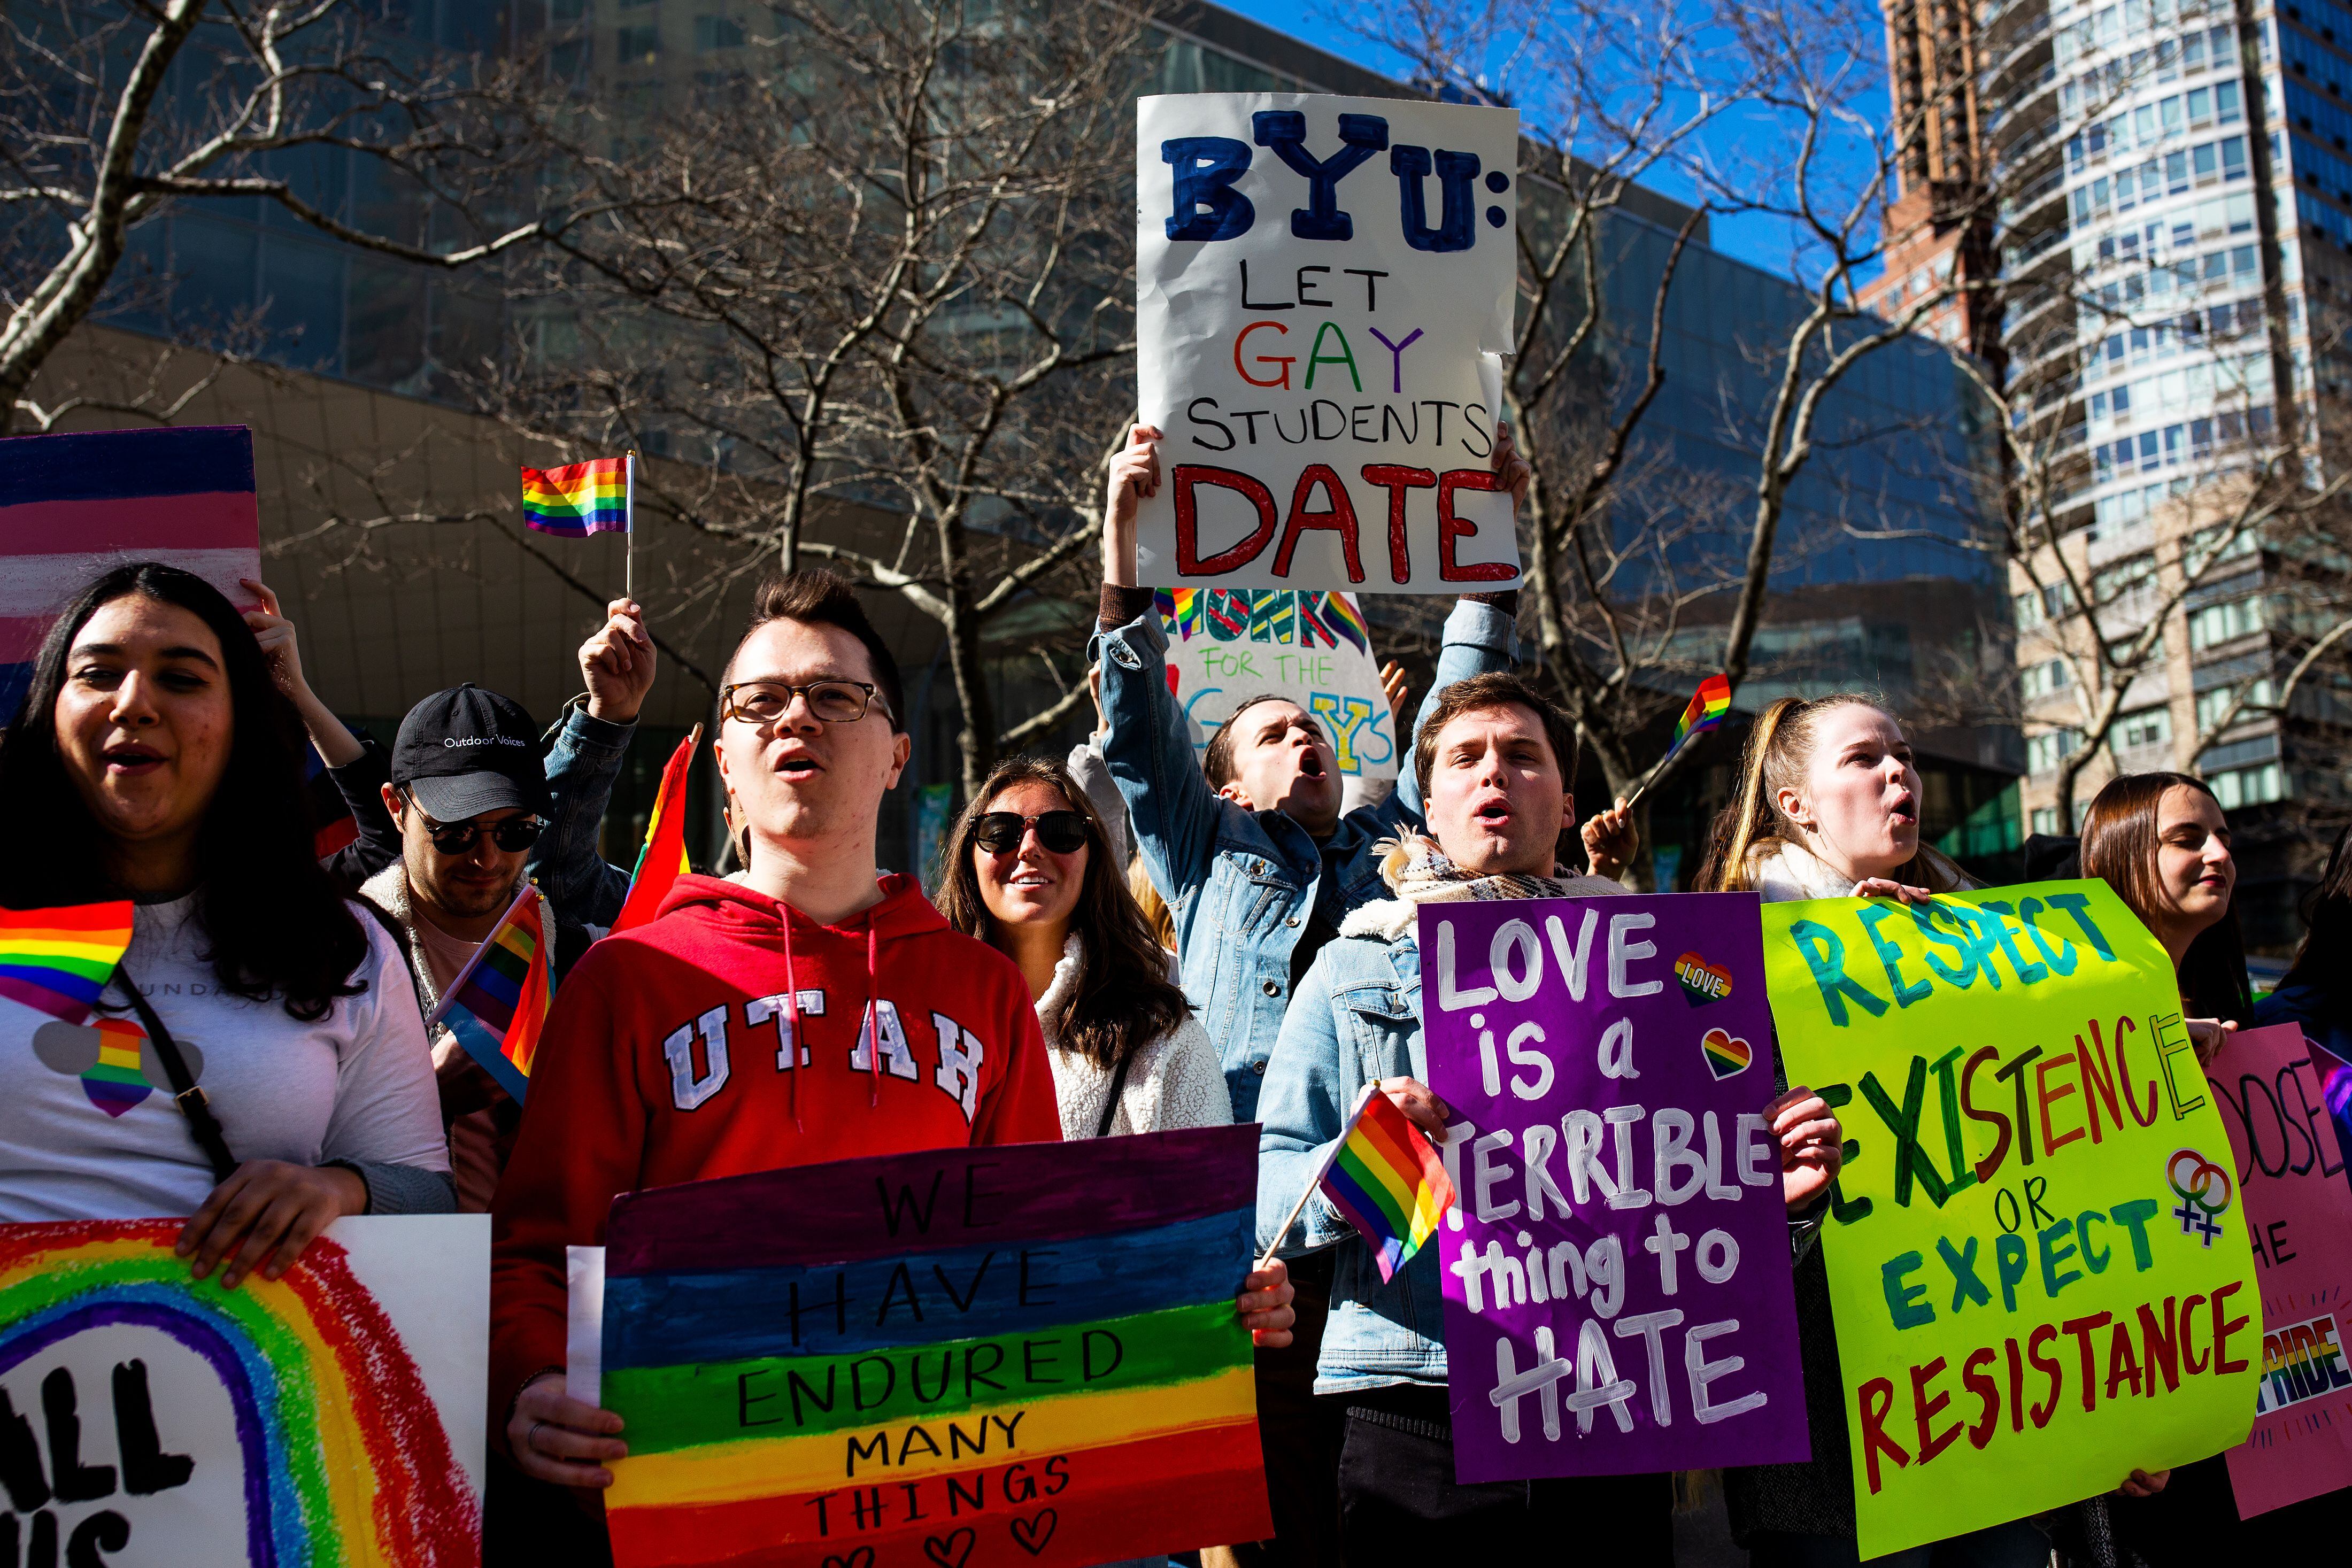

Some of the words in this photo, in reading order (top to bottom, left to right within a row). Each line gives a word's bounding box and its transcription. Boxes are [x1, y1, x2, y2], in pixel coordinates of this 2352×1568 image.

[1162, 111, 1509, 252] BYU:
[1240, 259, 1389, 311] LET
[1234, 321, 1424, 393] GAY
[1187, 397, 1492, 458] STUDENTS
[1172, 463, 1520, 584] DATE
[1162, 588, 1339, 650] ONK
[1198, 647, 1263, 678] FOR
[1273, 655, 1333, 685] THE
[444, 735, 494, 748] Outdoor
[495, 734, 525, 747] Voices
[1183, 688, 1392, 776] GYS
[1437, 908, 1663, 1012] LOVE
[1682, 962, 1723, 998] LOVE
[1790, 893, 2117, 1027] RESPECT
[662, 988, 984, 1126] UTAH
[1598, 1017, 1639, 1079] a
[875, 1162, 1001, 1238] WE
[1433, 1103, 1773, 1231] TERRIBLE
[1994, 1177, 2054, 1233] OR
[786, 1250, 1061, 1347] HAVE
[1450, 1230, 1625, 1318] thing
[1644, 1212, 1739, 1296] to
[1881, 1199, 2158, 1331] EXPECT
[738, 1329, 1123, 1428] ENDURED
[1489, 1308, 1768, 1443] HATE
[1857, 1281, 2249, 1496] RESISTANCE
[845, 1410, 1026, 1477] MANY
[804, 1454, 1069, 1537] THINGS
